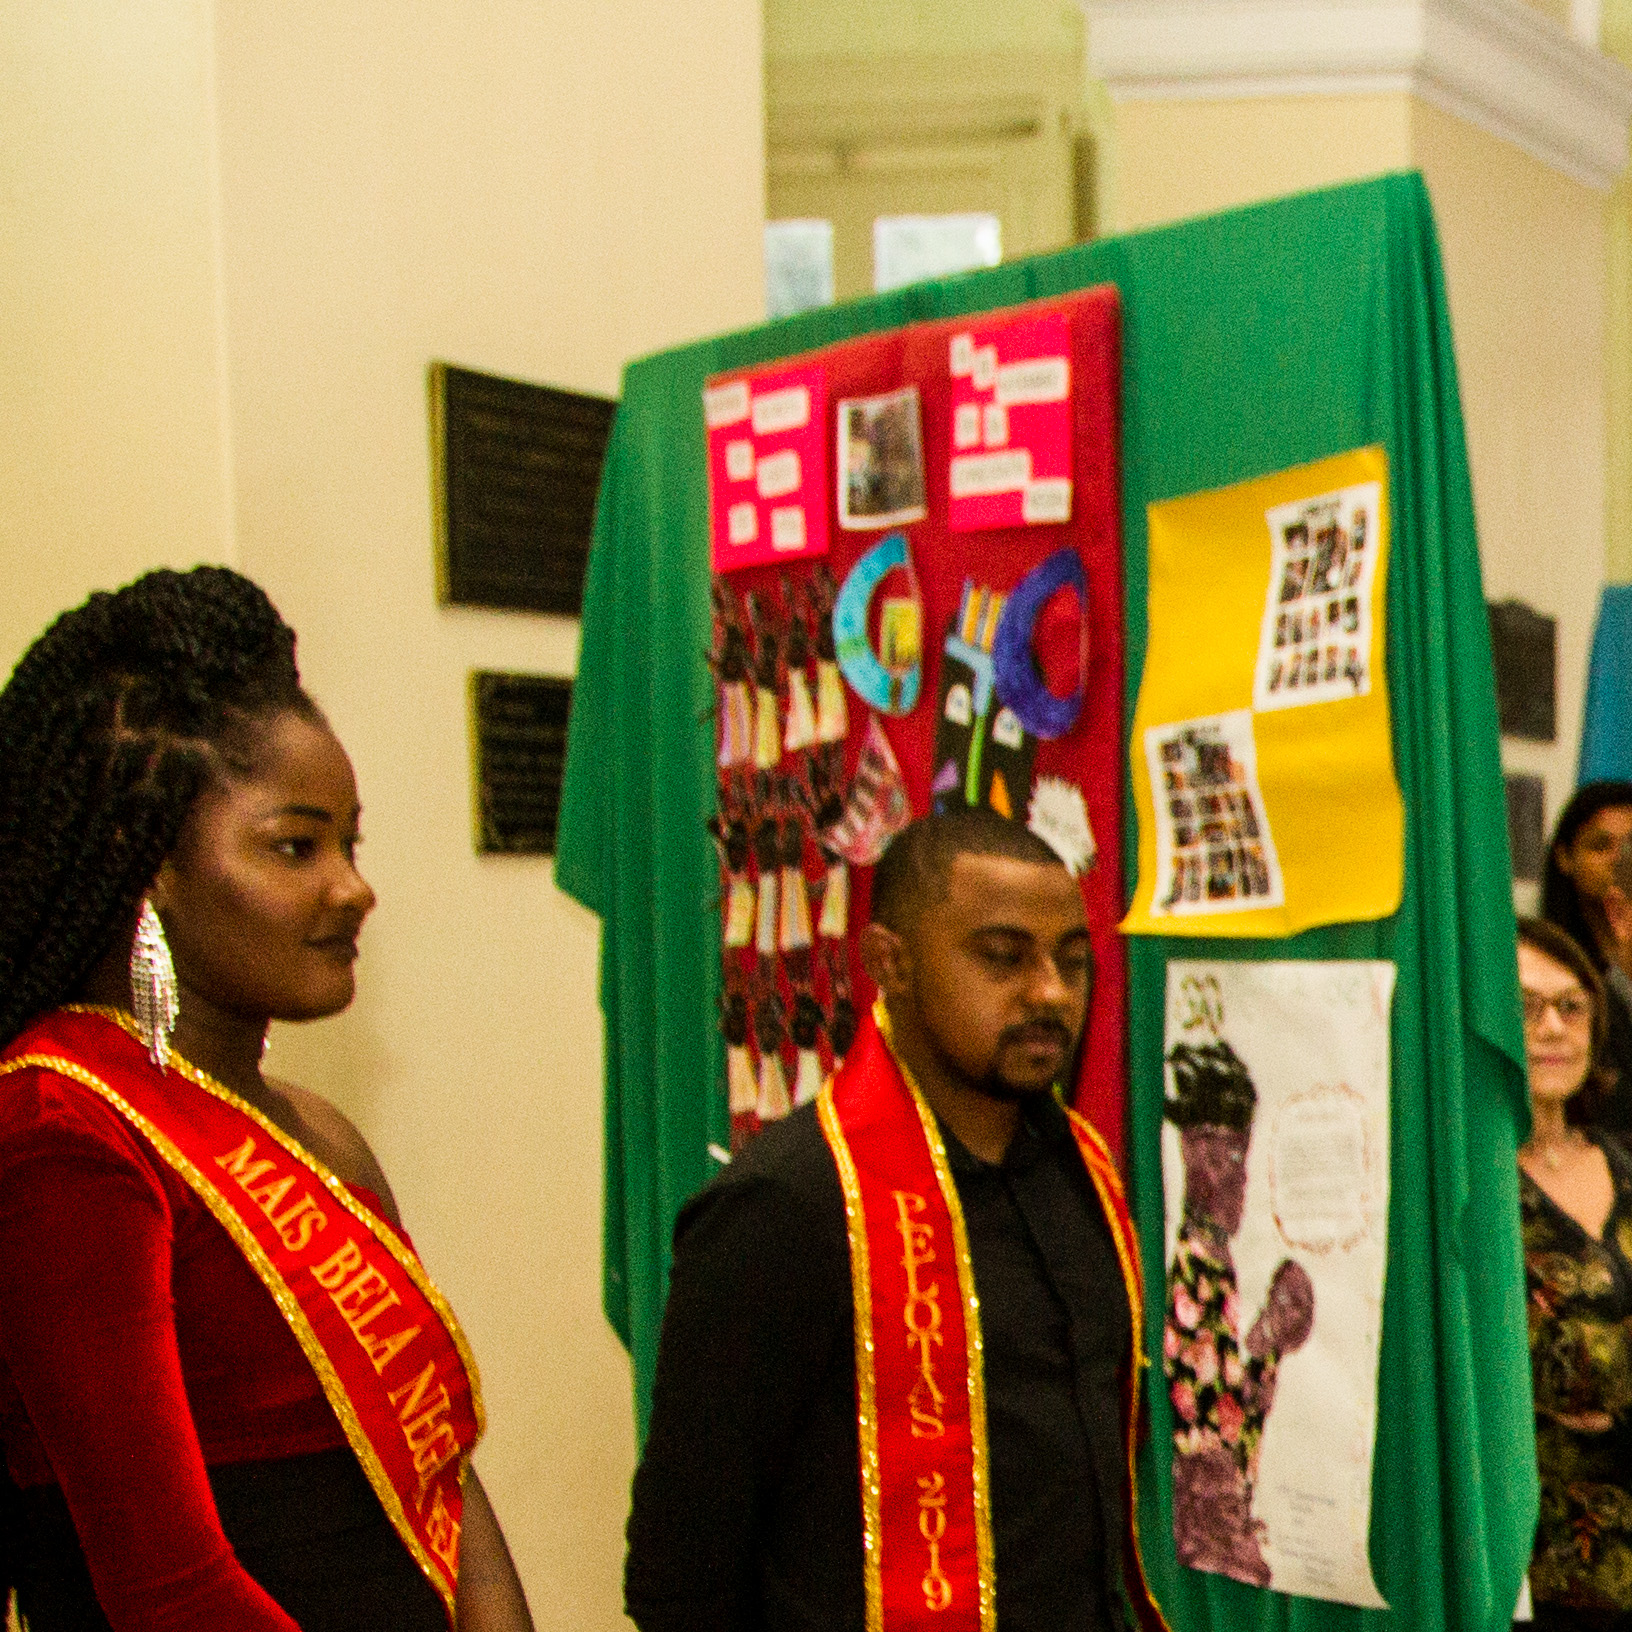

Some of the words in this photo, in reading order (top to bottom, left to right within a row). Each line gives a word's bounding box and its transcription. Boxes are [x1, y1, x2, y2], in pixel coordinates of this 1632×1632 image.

[213, 1134, 328, 1252] MAIS
[309, 1238, 423, 1375] BELA
[890, 1190, 945, 1439] PELOTAS
[917, 1470, 953, 1612] 2019
